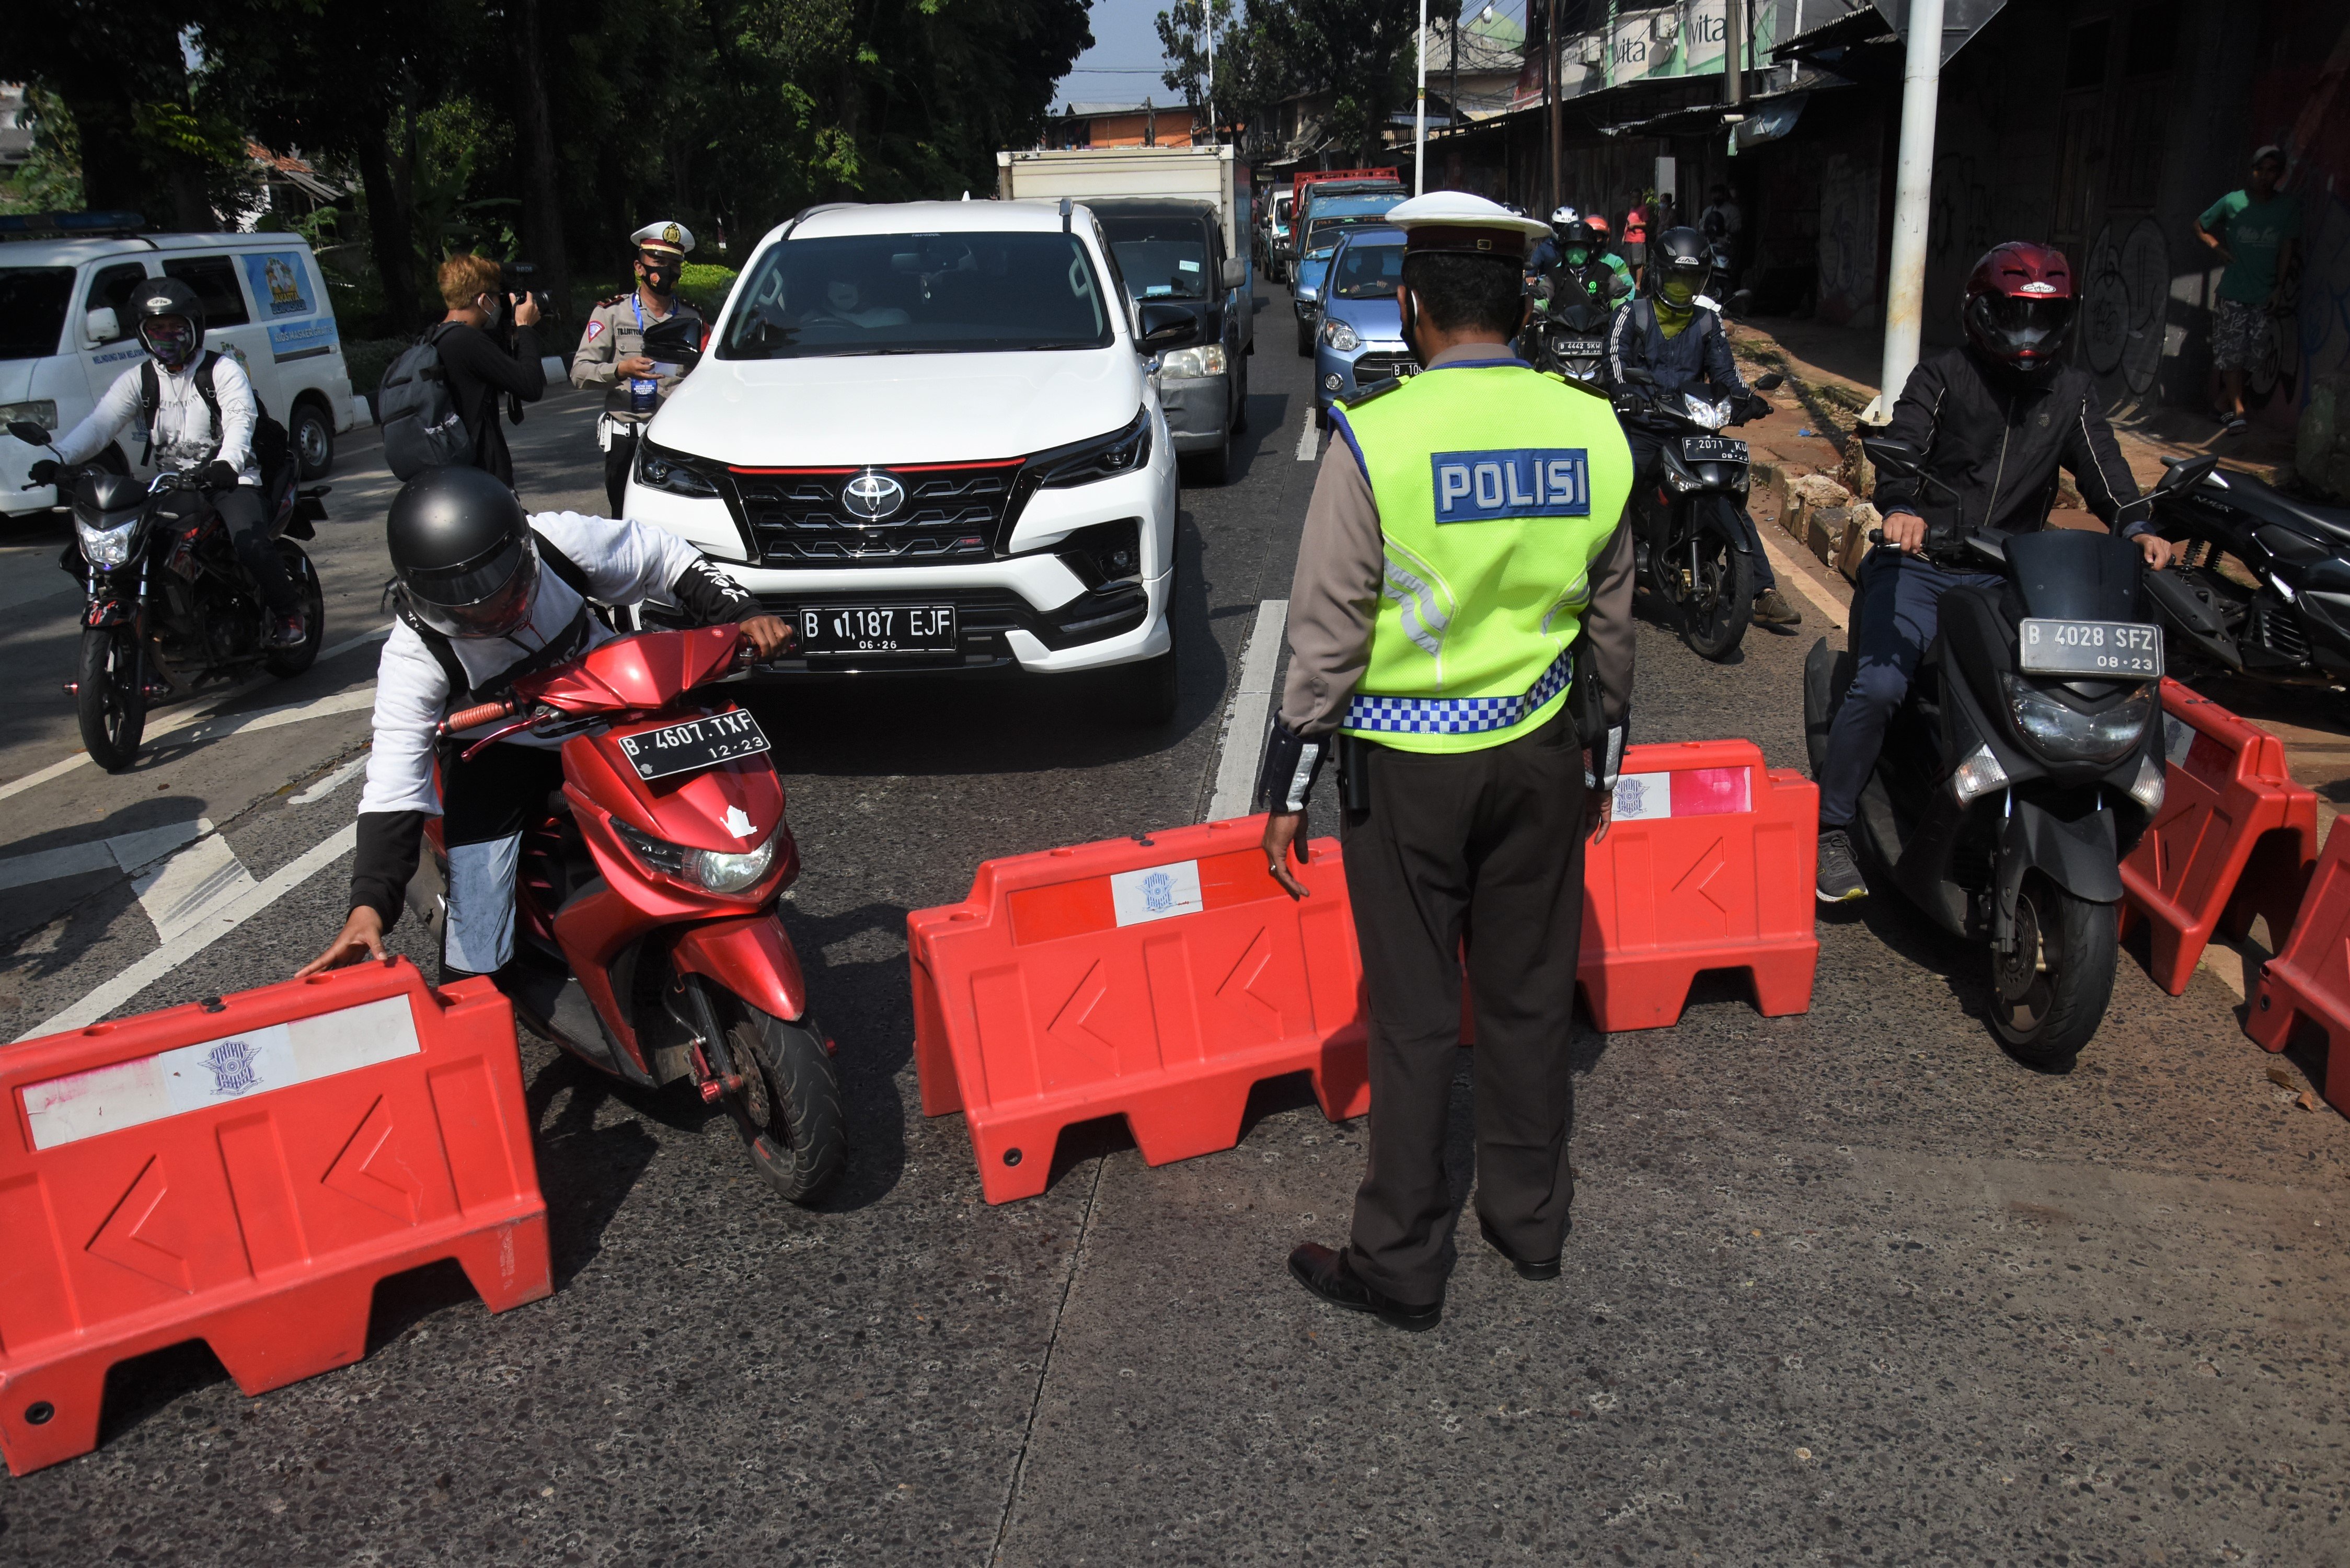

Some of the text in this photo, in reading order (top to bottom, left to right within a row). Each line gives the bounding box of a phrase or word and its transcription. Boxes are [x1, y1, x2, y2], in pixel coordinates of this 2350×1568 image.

[290, 328, 314, 340] MASKER
[1394, 365, 1400, 376] B
[1685, 440, 1747, 452] F 2071 KU
[1438, 458, 1587, 513] POLISI
[805, 613, 819, 638] B
[911, 610, 950, 636] EJF
[2029, 625, 2153, 651] B 4028 SFZ
[622, 712, 751, 756] B 4607 TXF
